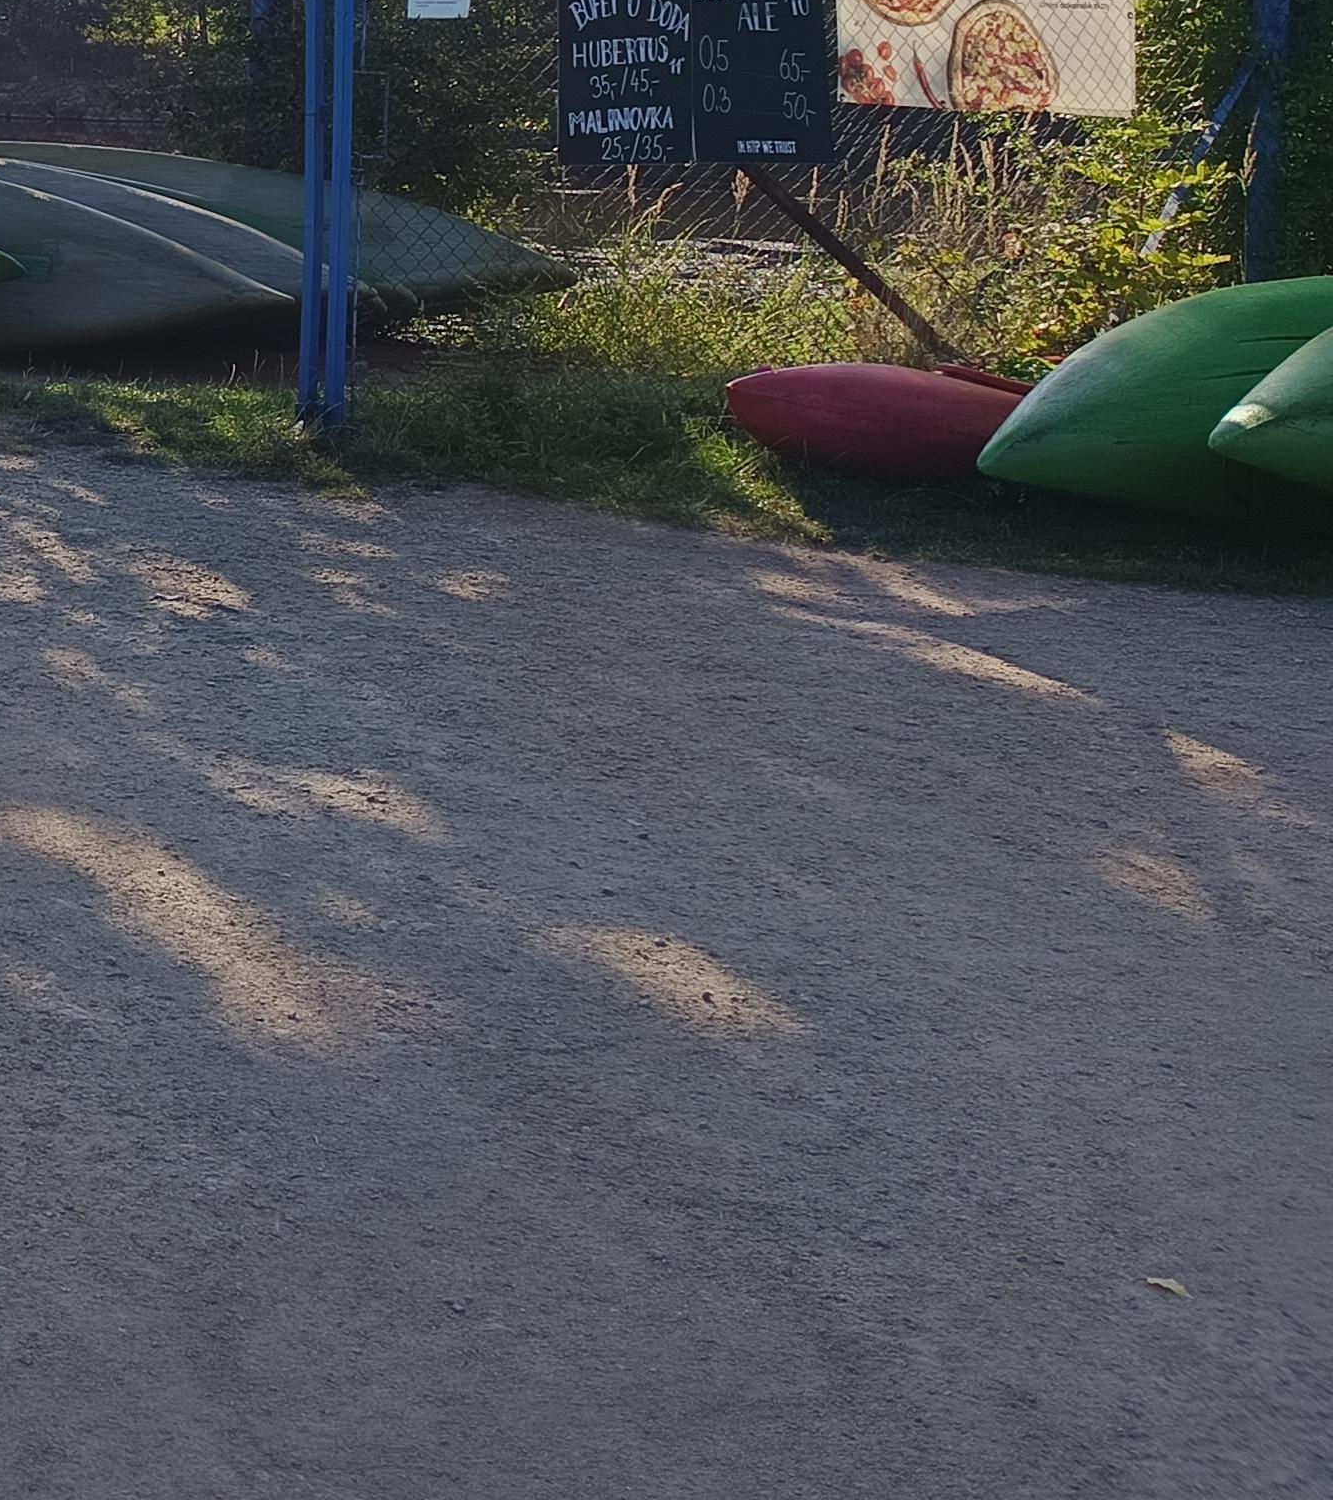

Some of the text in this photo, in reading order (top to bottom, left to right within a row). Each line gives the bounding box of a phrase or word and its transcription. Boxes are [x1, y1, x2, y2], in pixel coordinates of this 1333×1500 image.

[737, 2, 780, 32] ALE
[572, 35, 669, 68] HUBERTUS
[699, 35, 729, 73] 0,5
[568, 106, 674, 137] MALINOVKA
